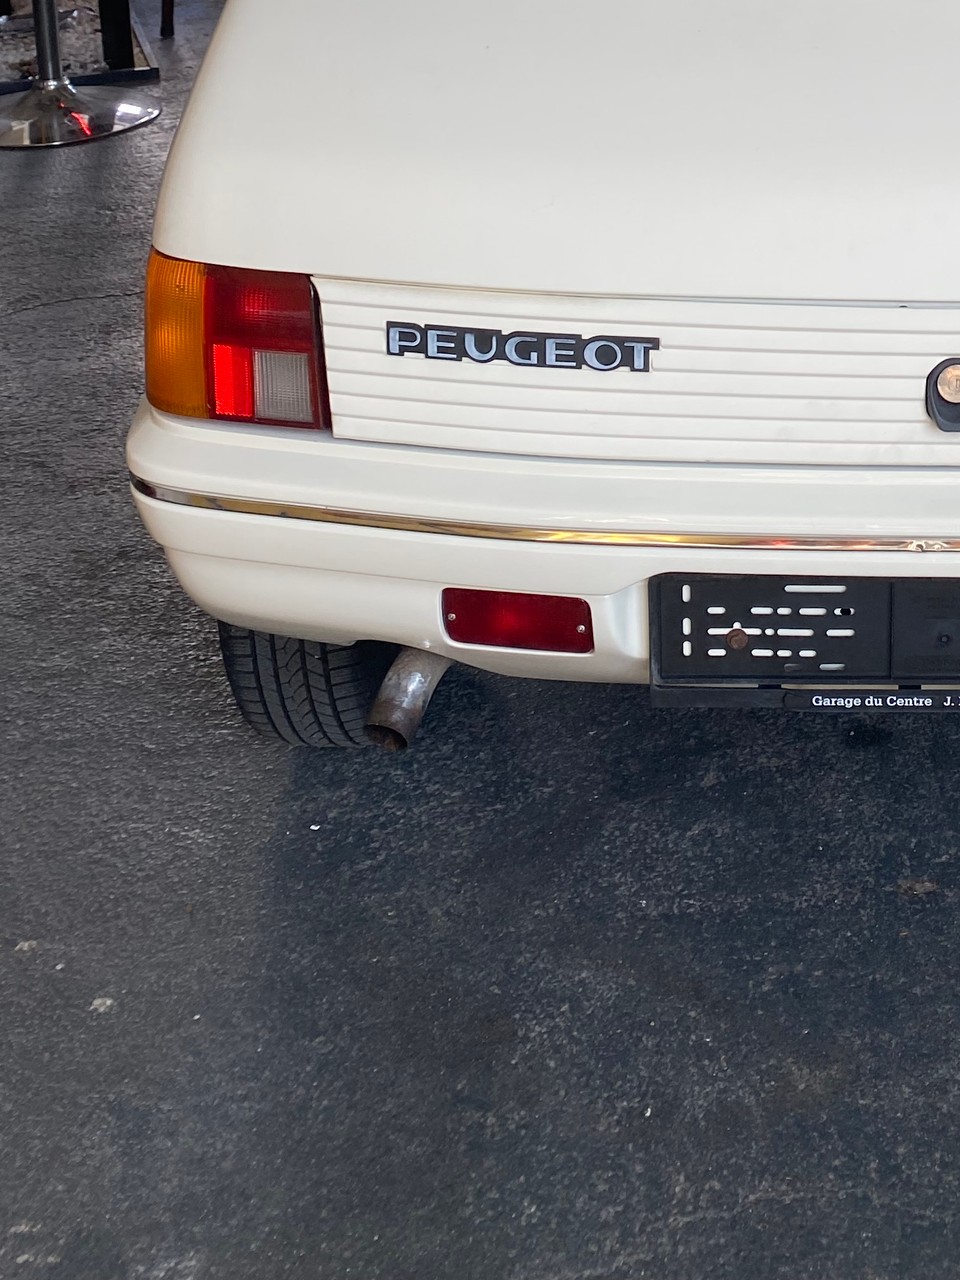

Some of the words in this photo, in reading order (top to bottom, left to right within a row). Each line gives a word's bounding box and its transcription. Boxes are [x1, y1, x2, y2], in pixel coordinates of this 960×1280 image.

[387, 324, 654, 371] PEUGEOT
[811, 695, 862, 708] Garage
[864, 694, 883, 707] du
[886, 695, 933, 707] Centre
[943, 695, 955, 707] J.
